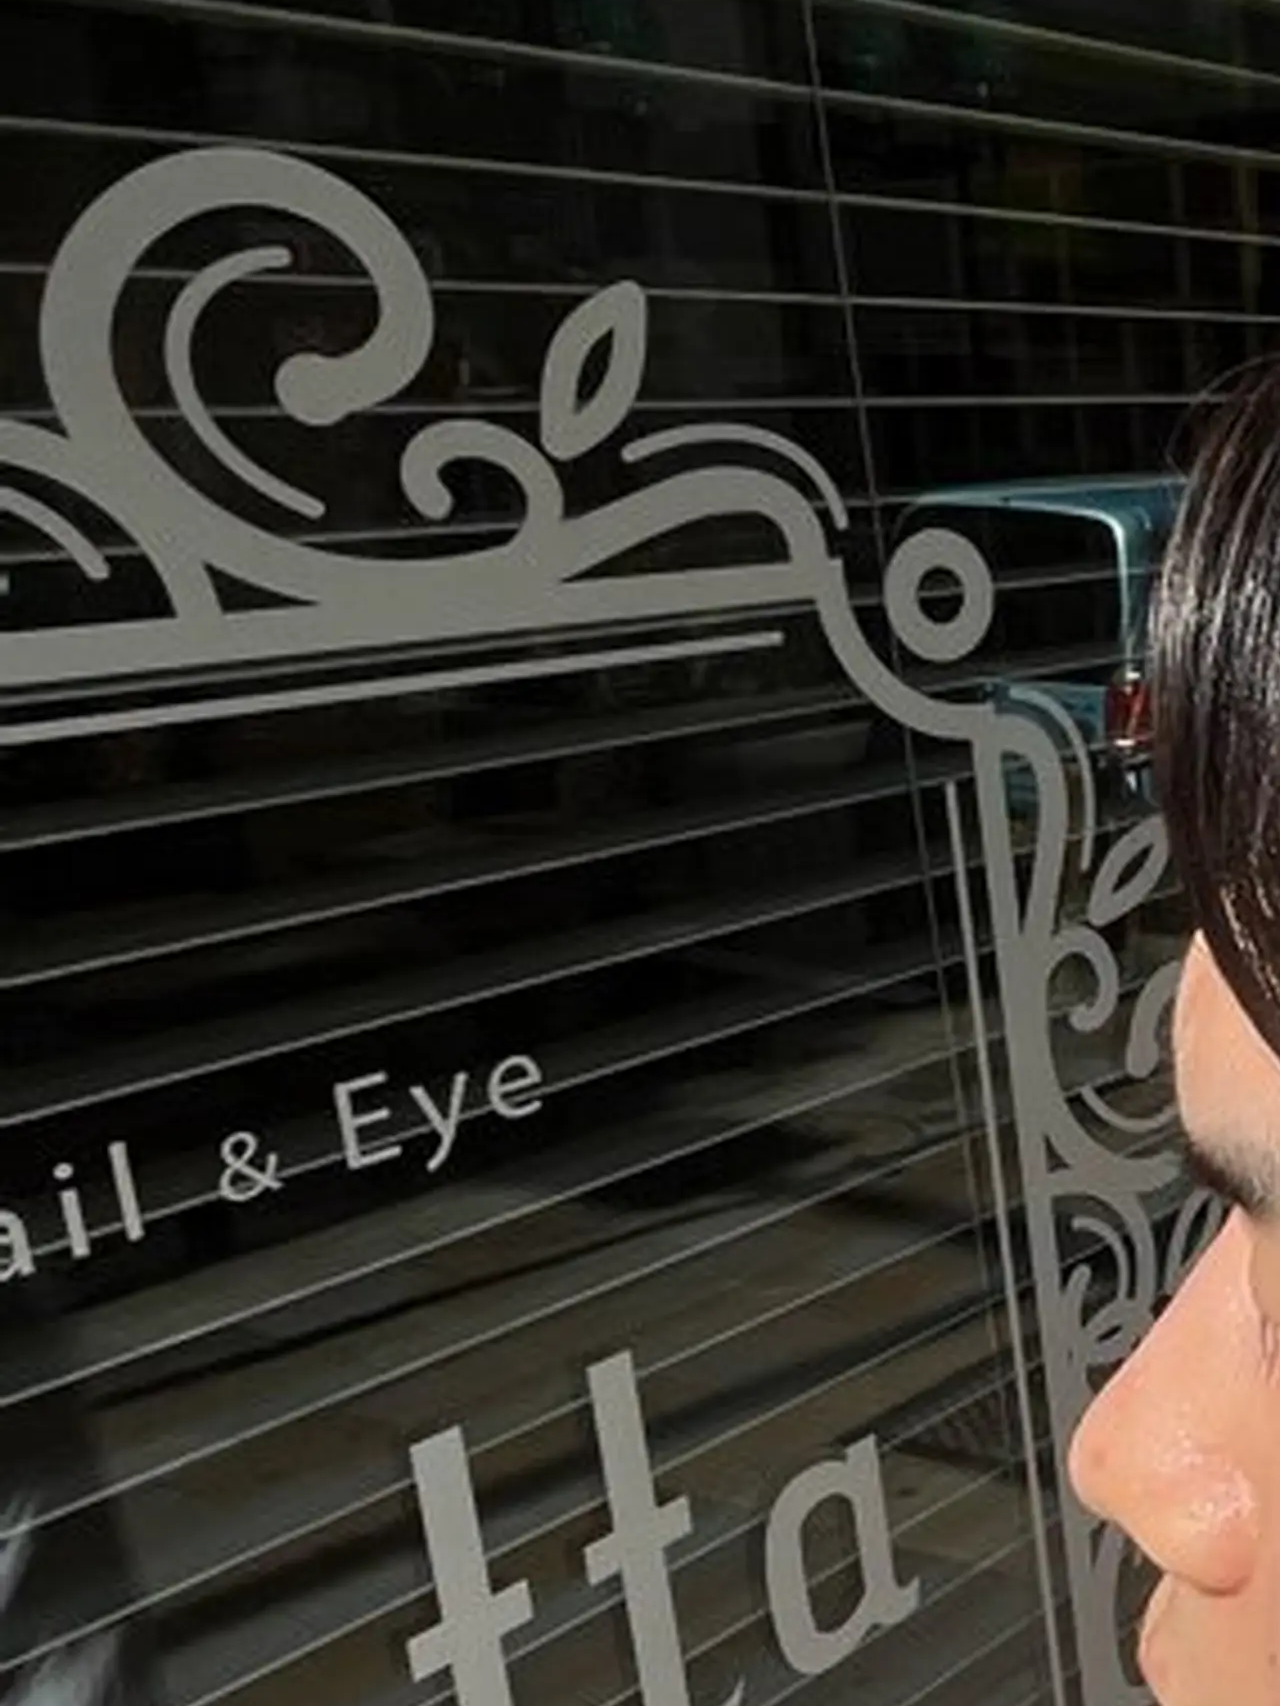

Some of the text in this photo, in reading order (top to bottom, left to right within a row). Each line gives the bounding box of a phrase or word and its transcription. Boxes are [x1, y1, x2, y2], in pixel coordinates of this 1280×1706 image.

[0, 1054, 543, 1282] ail & Eye
